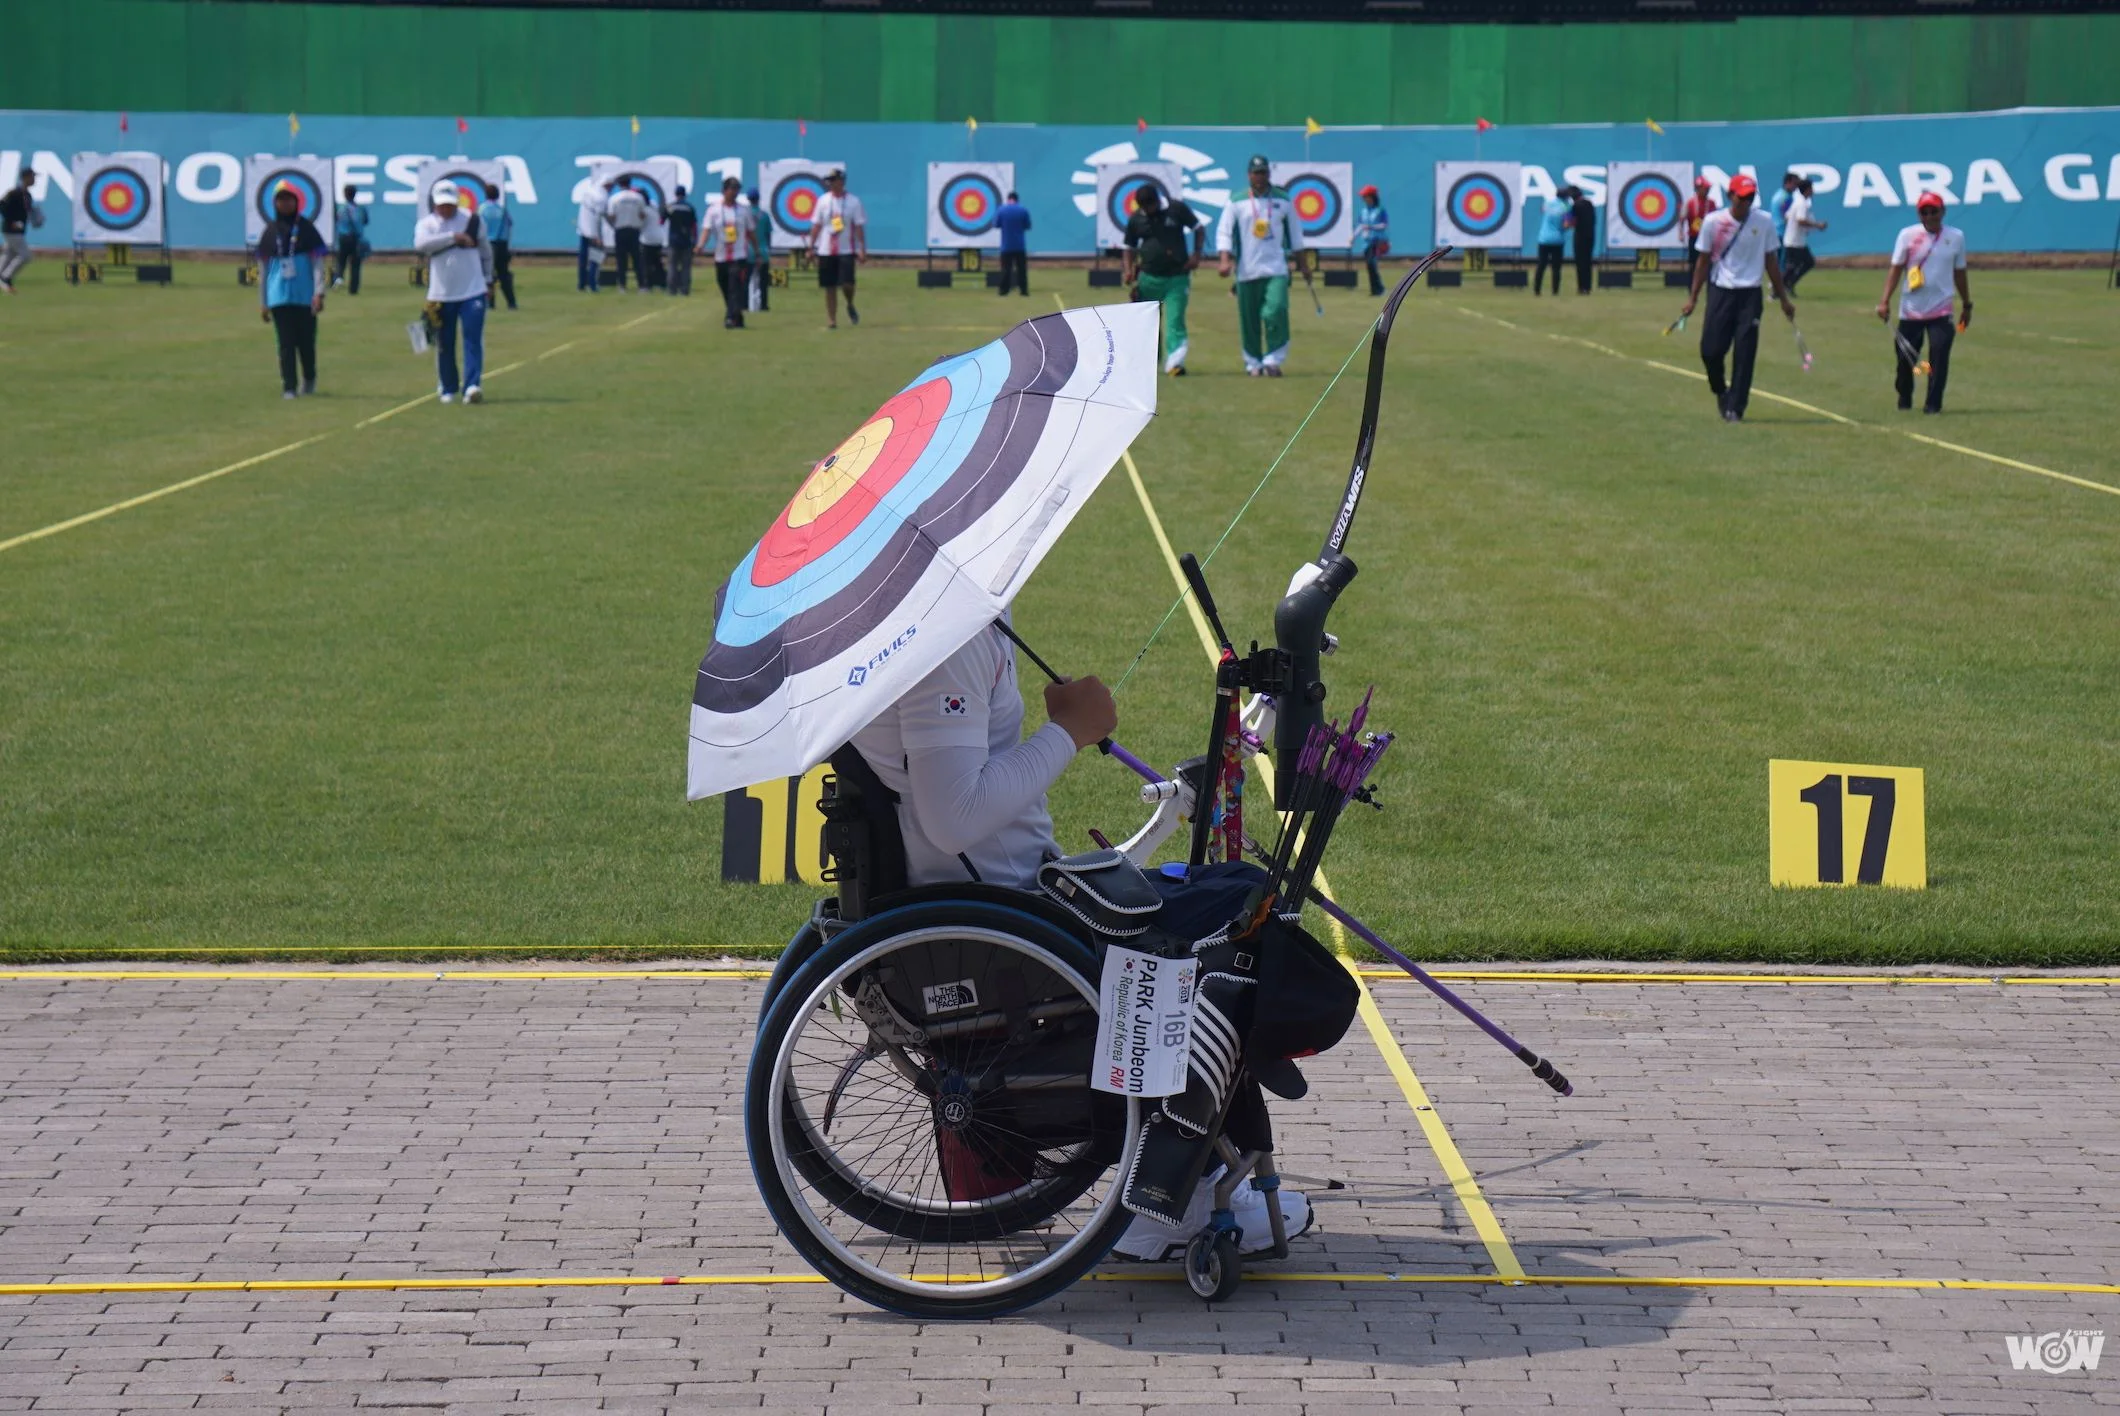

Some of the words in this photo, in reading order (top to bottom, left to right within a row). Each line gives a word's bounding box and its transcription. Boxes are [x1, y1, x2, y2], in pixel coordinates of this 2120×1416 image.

[1786, 158, 2023, 208] PARA
[2043, 153, 2120, 202] G
[1330, 465, 1364, 549] WIAWIS
[868, 623, 917, 670] FIVICS
[1800, 774, 1896, 885] 17
[928, 993, 958, 1004] NORTH
[938, 1000, 958, 1008] FACE
[939, 986, 956, 994] THE
[1116, 975, 1133, 1019] Republic
[1134, 958, 1157, 1012] PARK
[1112, 1032, 1125, 1062] Korea
[1115, 1020, 1126, 1033] of
[1163, 1010, 1187, 1048] 16B
[1129, 1014, 1153, 1093] Junbeom
[1110, 1066, 1125, 1089] RM
